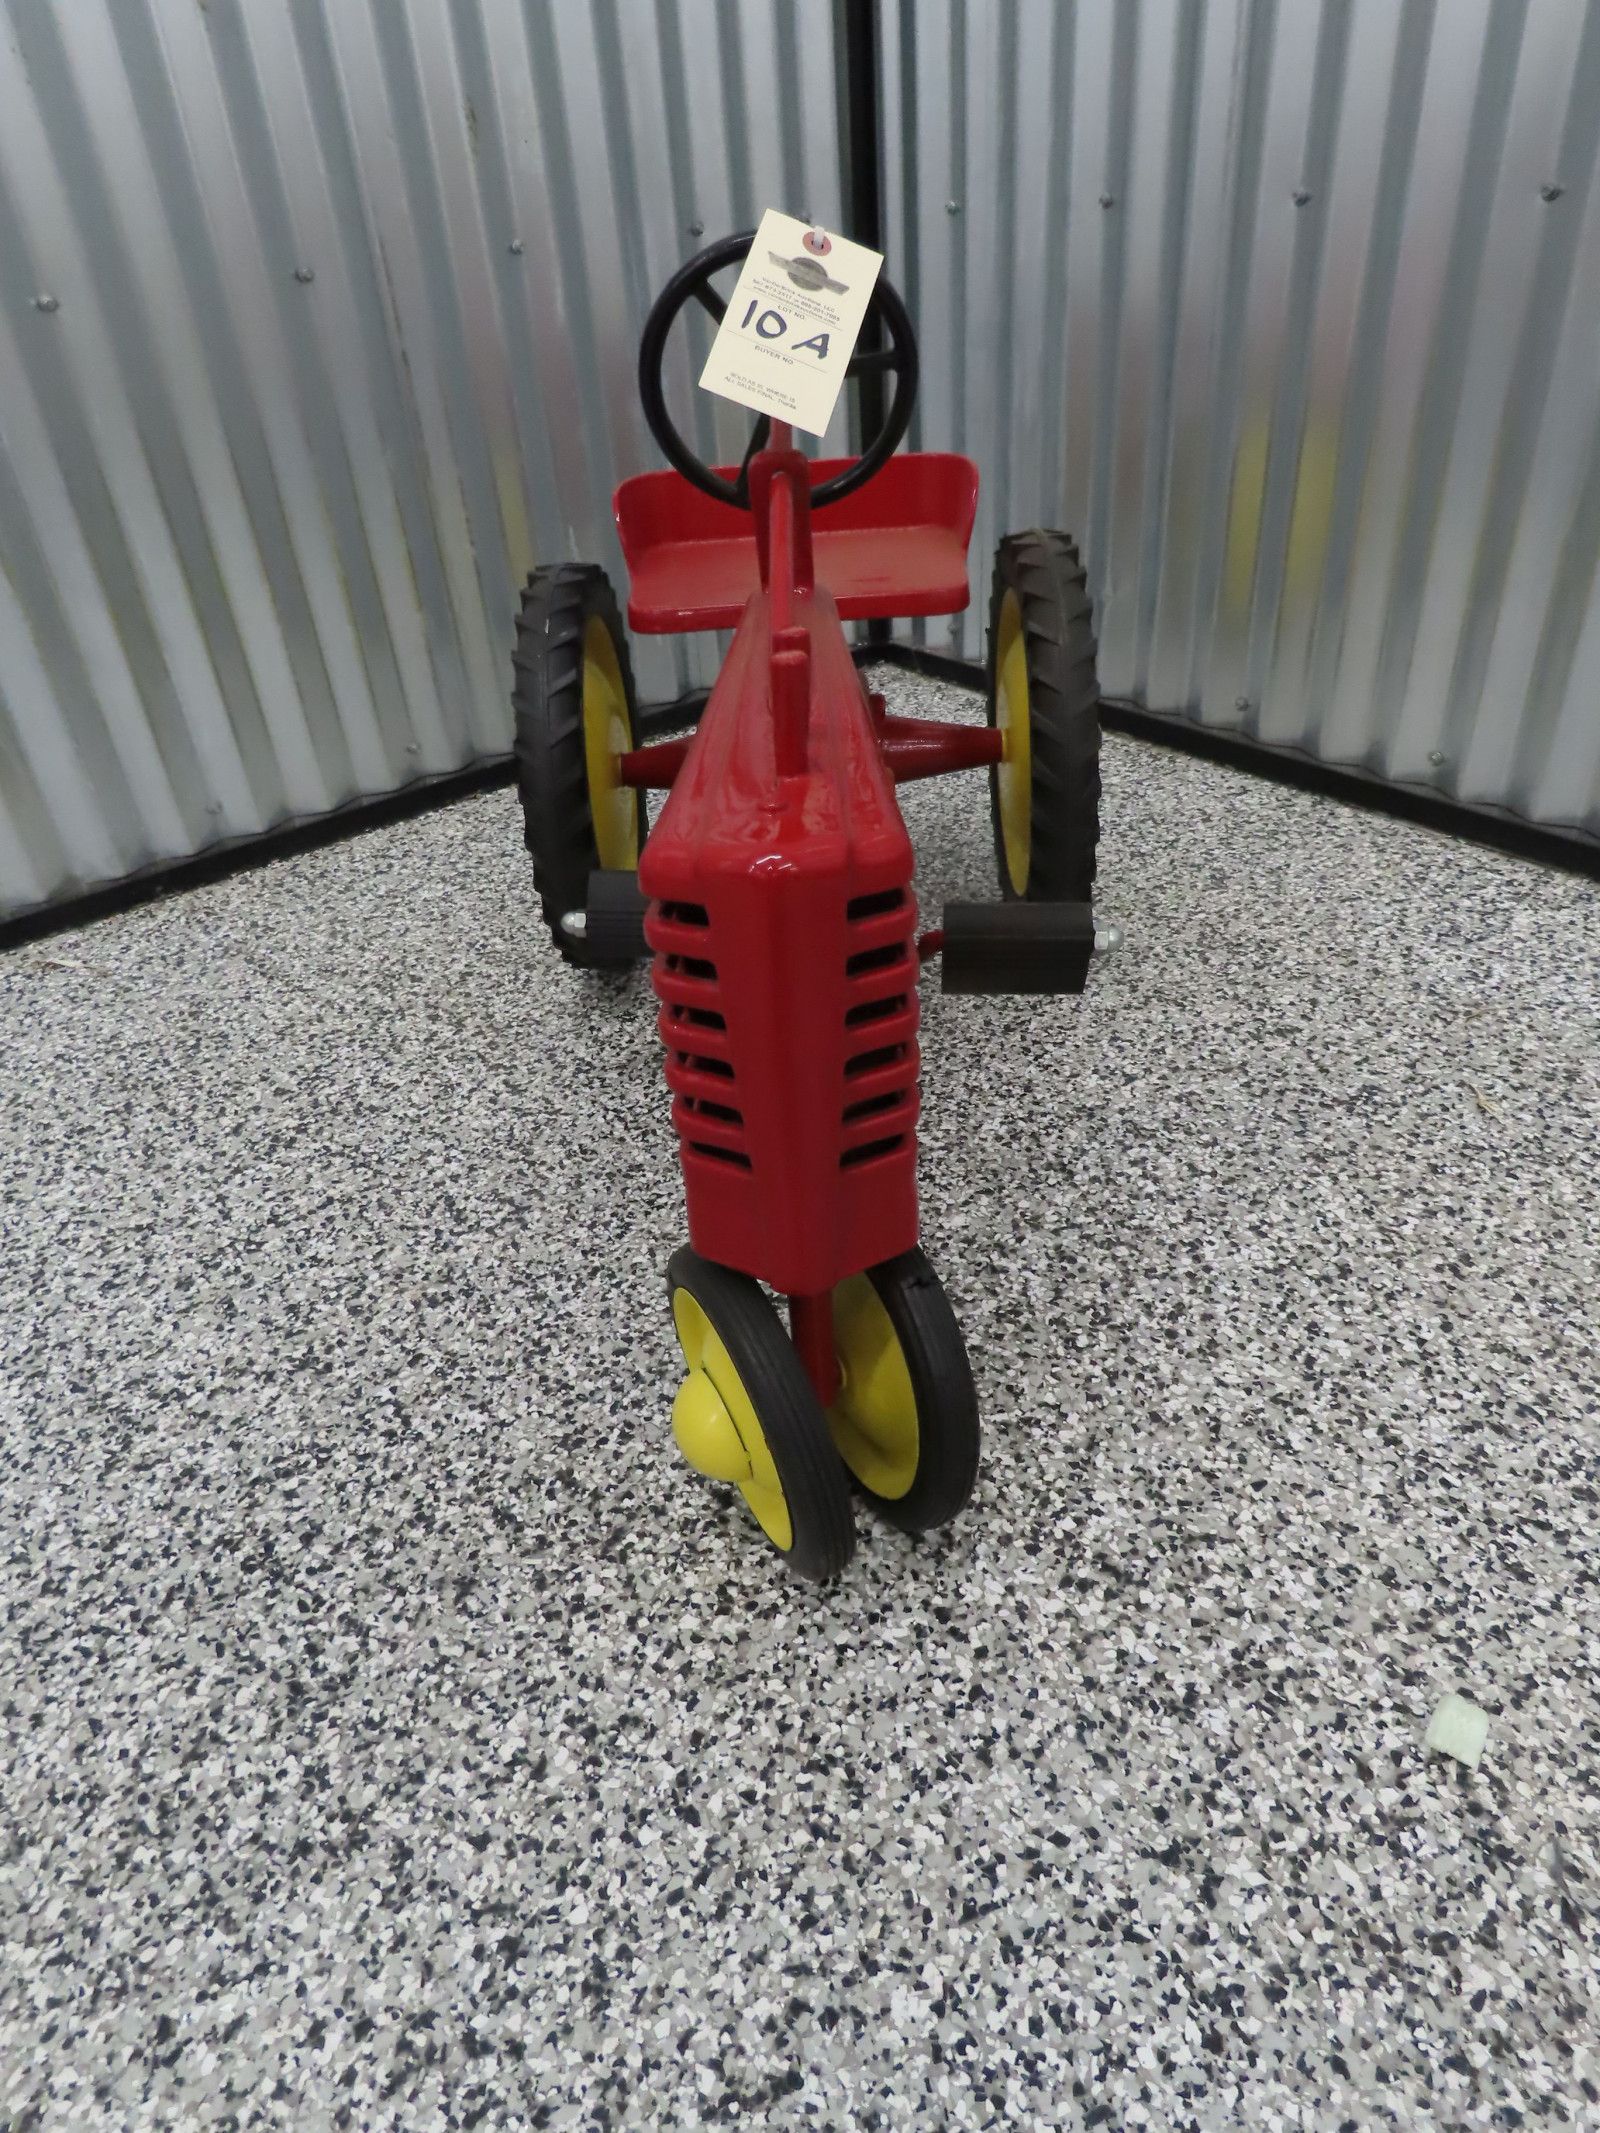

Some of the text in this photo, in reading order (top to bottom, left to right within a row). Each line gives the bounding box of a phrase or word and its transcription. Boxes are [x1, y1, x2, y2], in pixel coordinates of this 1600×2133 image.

[777, 304, 792, 314] LOT
[741, 299, 829, 359] 10 A
[754, 345, 780, 359] BUYER
